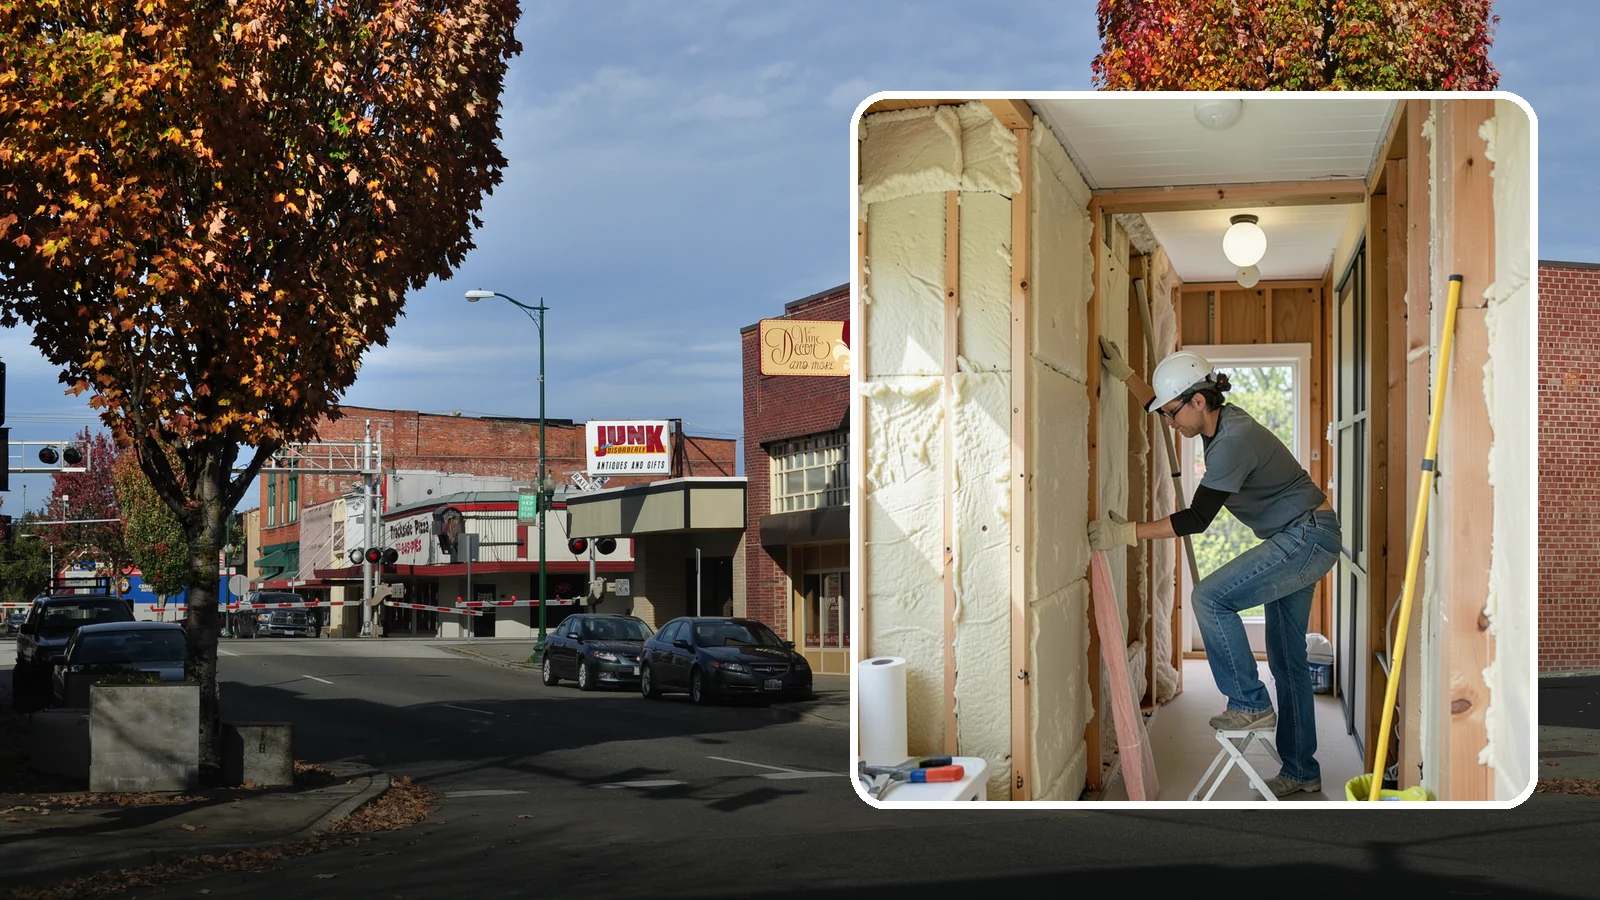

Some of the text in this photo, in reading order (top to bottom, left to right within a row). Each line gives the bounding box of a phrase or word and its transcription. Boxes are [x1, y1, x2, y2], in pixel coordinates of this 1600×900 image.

[765, 328, 831, 365] Decor
[595, 425, 665, 457] JUNK
[607, 446, 646, 454] DISORDERLY
[597, 460, 665, 470] ANTIQUES AND GIFTS
[390, 519, 429, 539] Trackside Pizza
